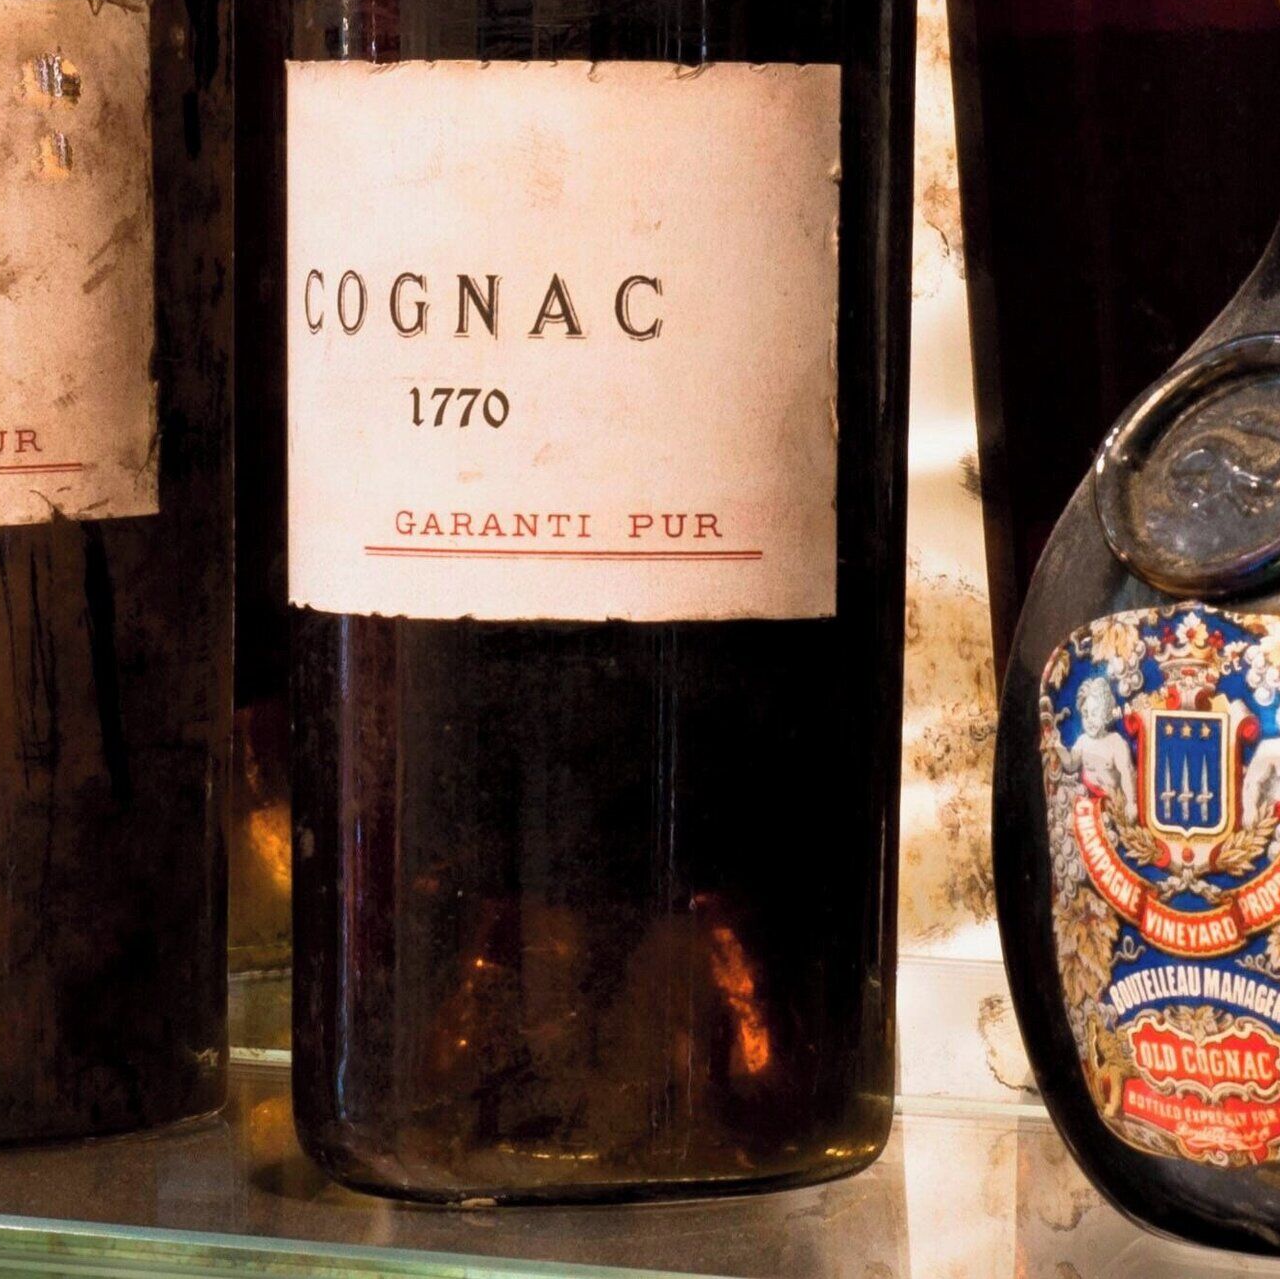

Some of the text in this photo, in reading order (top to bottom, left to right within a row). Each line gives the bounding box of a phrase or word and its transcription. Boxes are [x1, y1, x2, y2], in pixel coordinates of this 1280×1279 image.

[304, 269, 663, 341] COGNAC
[408, 387, 510, 429] 1770
[394, 510, 723, 539] GARANTI PUR
[1075, 798, 1142, 913] CHAMPAGNE
[1143, 910, 1238, 947] VINEYARD
[1109, 965, 1201, 1015] BOUTELLEAU
[1139, 1040, 1273, 1080] OLD COGNAC
[1128, 1090, 1182, 1121] BOTTLED
[1250, 1106, 1277, 1126] FOR
